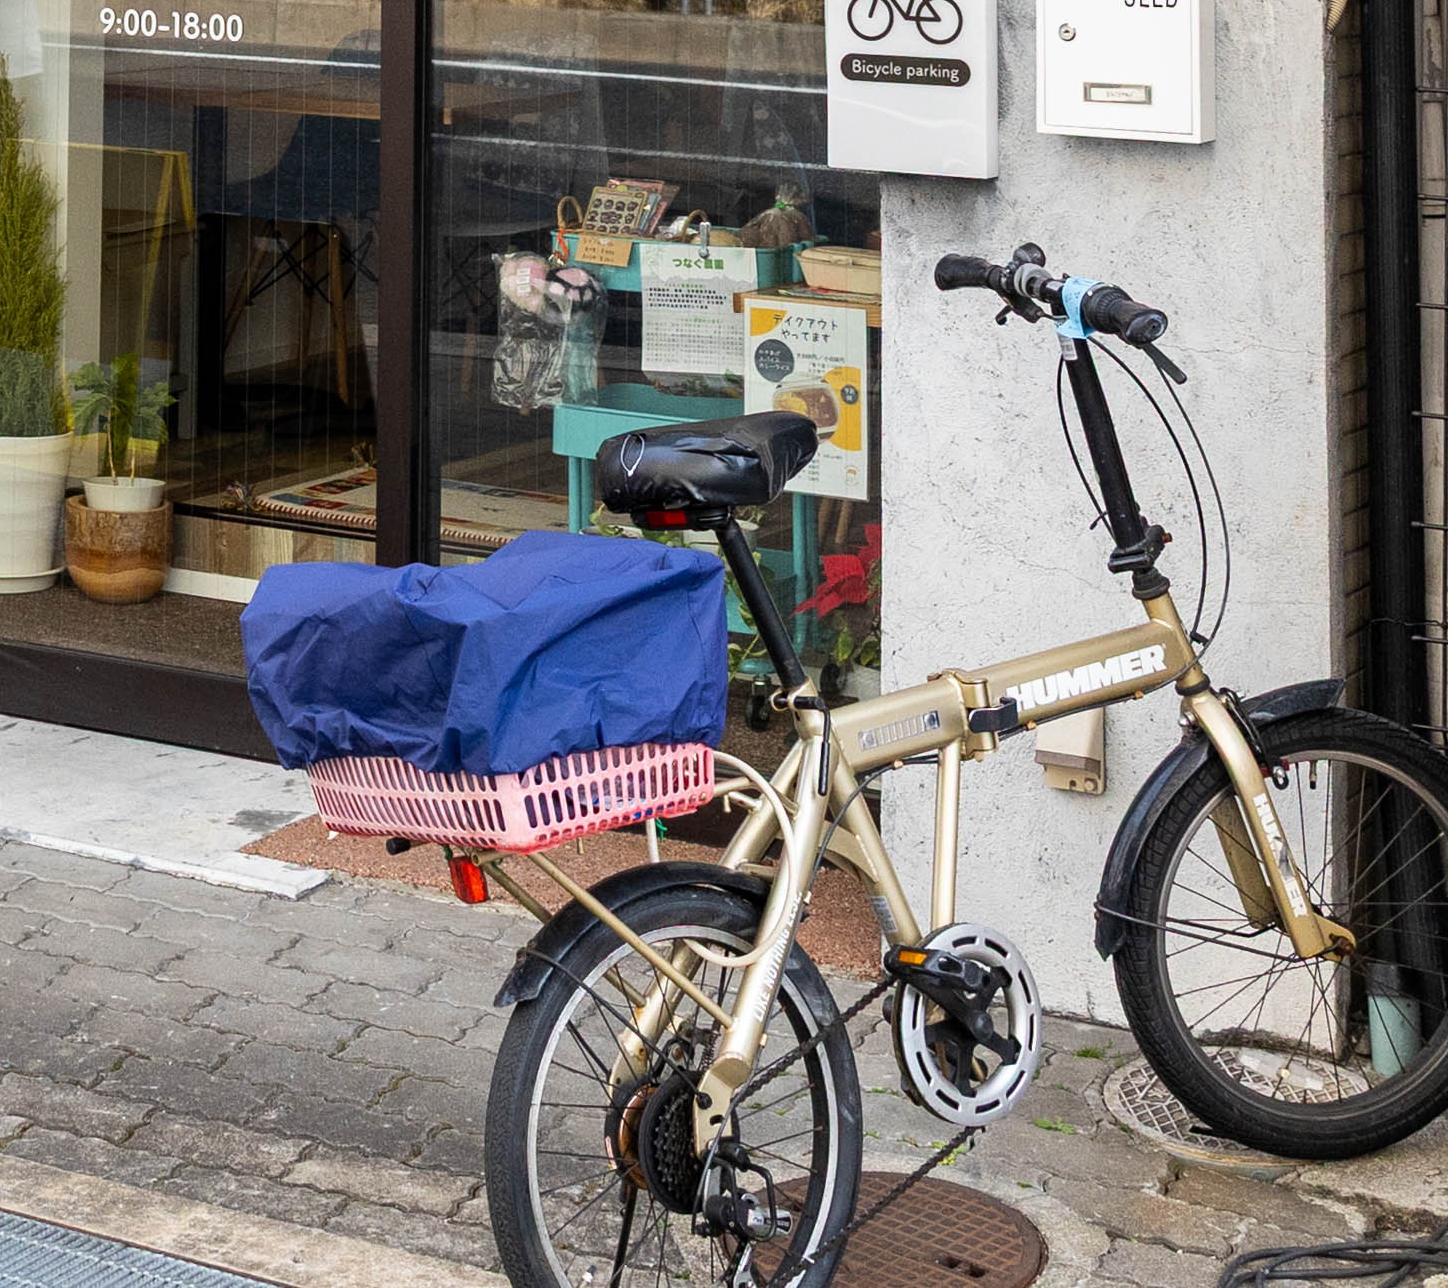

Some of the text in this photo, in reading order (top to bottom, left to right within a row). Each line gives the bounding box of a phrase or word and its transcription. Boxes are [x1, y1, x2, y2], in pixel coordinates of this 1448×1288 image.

[100, 7, 244, 43] 9:00-18:00
[851, 58, 960, 84] Bicycle parking
[773, 313, 839, 331] テイクアウト
[782, 329, 831, 343] やってます
[1006, 644, 1167, 713] HUMMER
[1253, 793, 1309, 918] HUER
[766, 925, 792, 990] NOTHING
